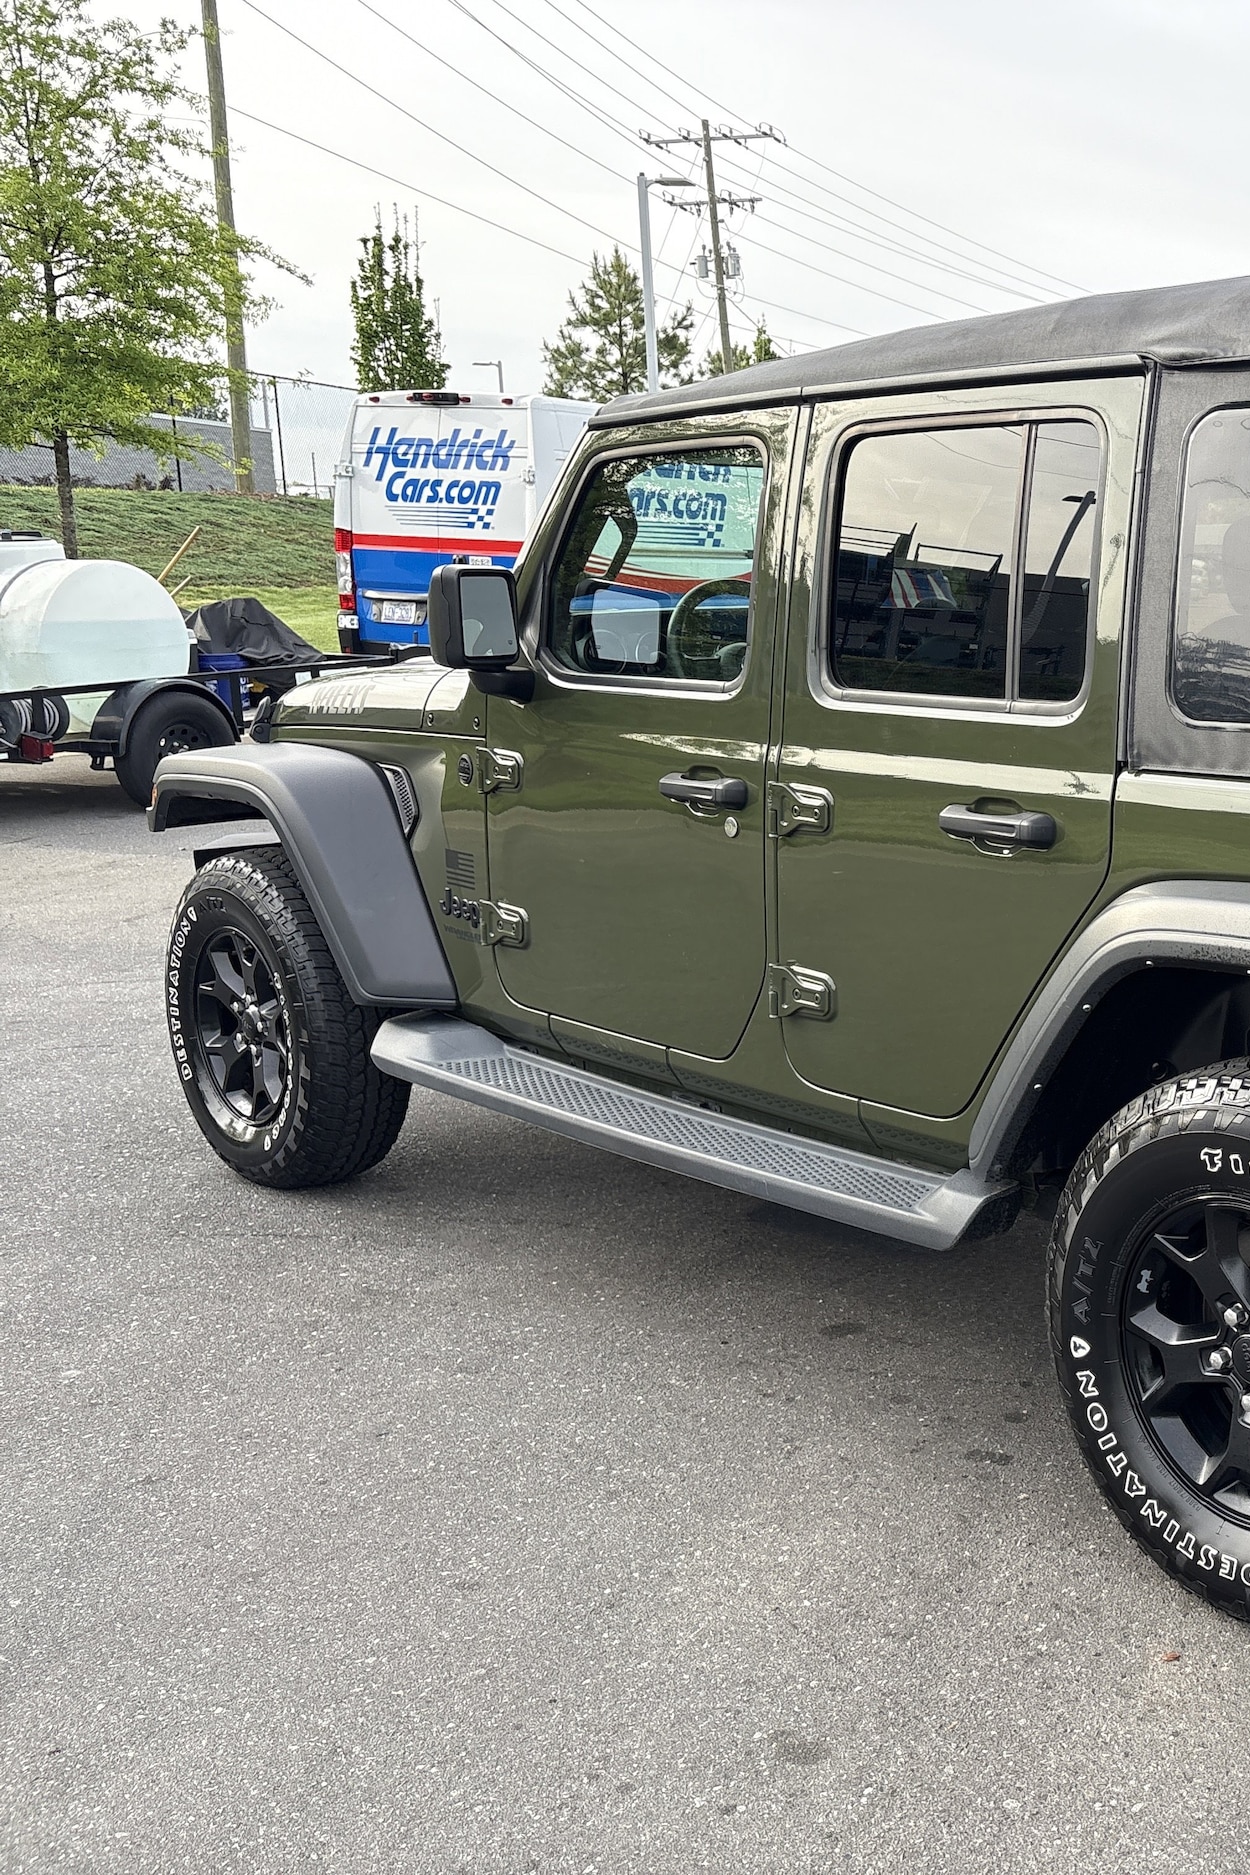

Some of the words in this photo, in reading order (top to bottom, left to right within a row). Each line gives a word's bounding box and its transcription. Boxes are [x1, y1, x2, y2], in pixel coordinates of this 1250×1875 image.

[363, 427, 516, 481] Hendrick
[385, 471, 502, 506] Cars.com
[627, 487, 727, 521] ars.com
[439, 887, 480, 929] Jeep
[168, 917, 193, 1082] DESTINATION
[1071, 1236, 1104, 1326] A/T2
